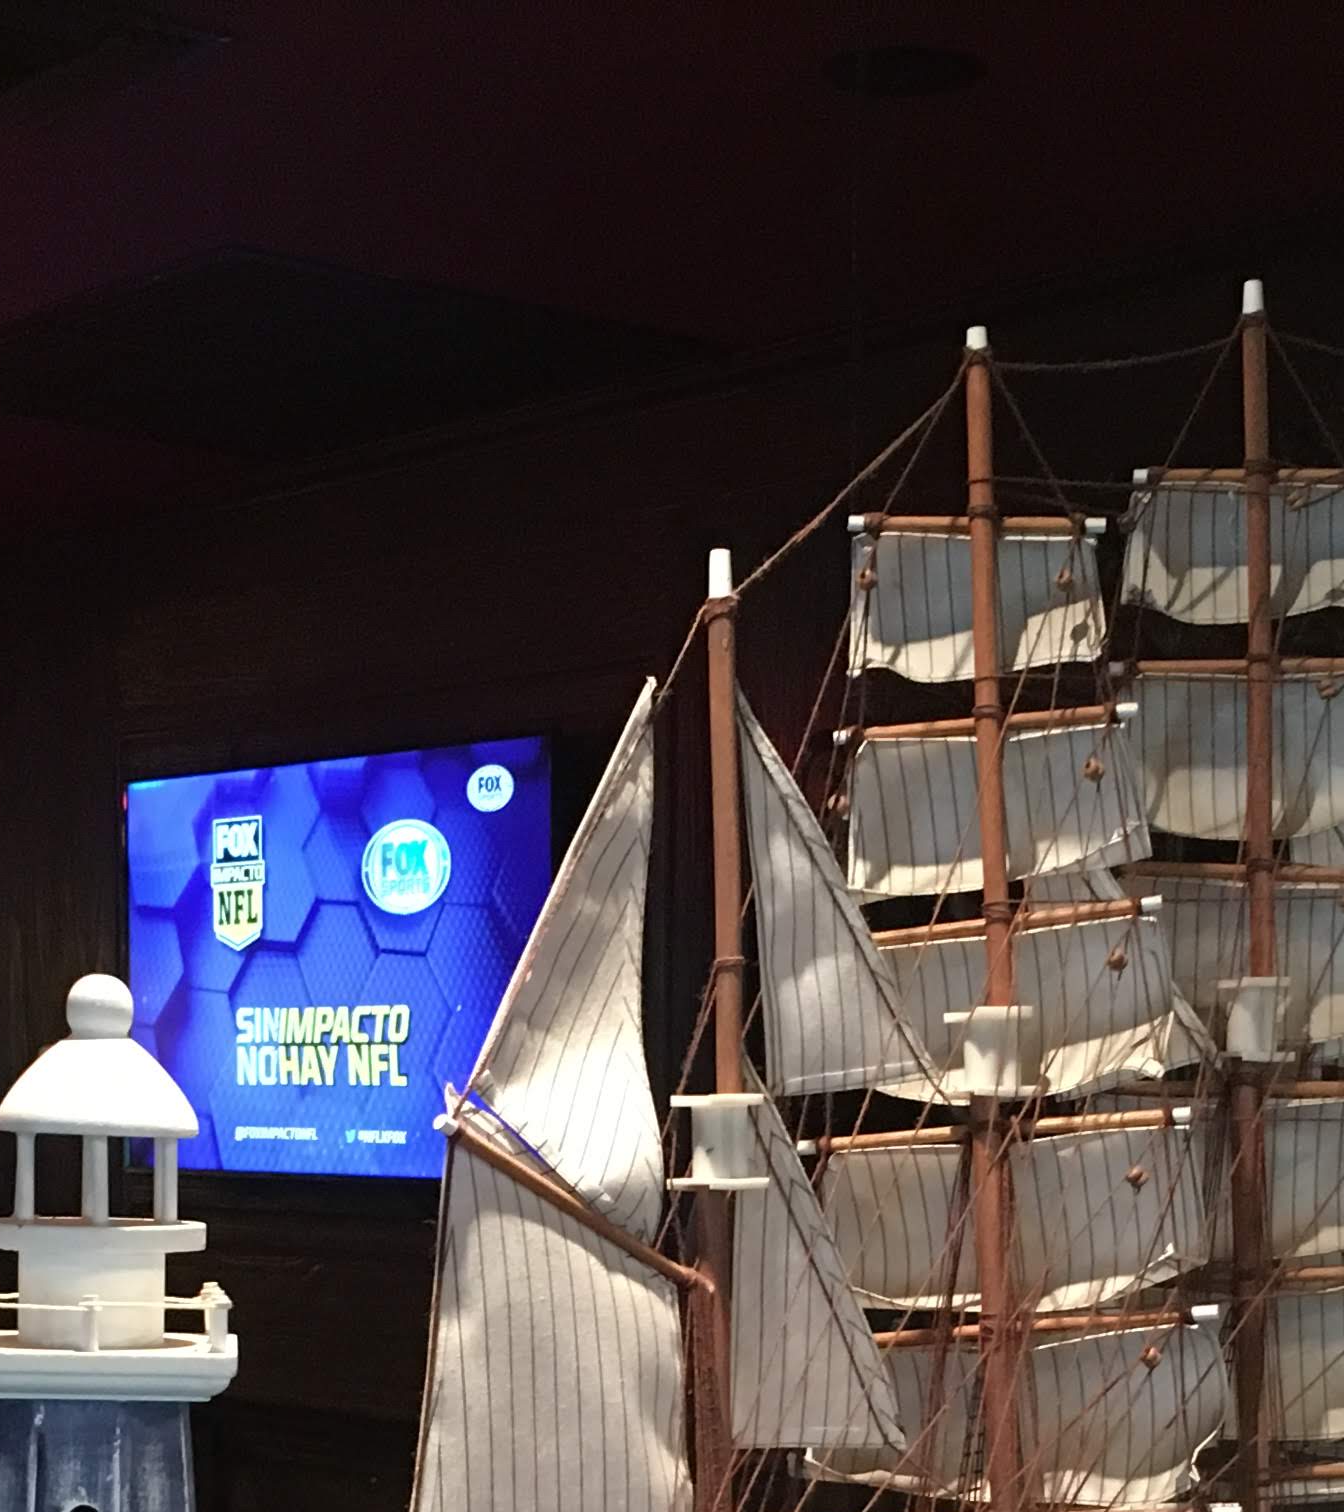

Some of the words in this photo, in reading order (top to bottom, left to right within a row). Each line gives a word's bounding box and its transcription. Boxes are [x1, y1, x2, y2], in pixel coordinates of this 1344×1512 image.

[478, 775, 502, 793] FOX
[216, 821, 258, 860] FOX
[381, 839, 428, 878] FOX
[381, 877, 431, 896] SPORTS
[218, 889, 258, 925] NFL
[347, 1044, 408, 1086] NFL
